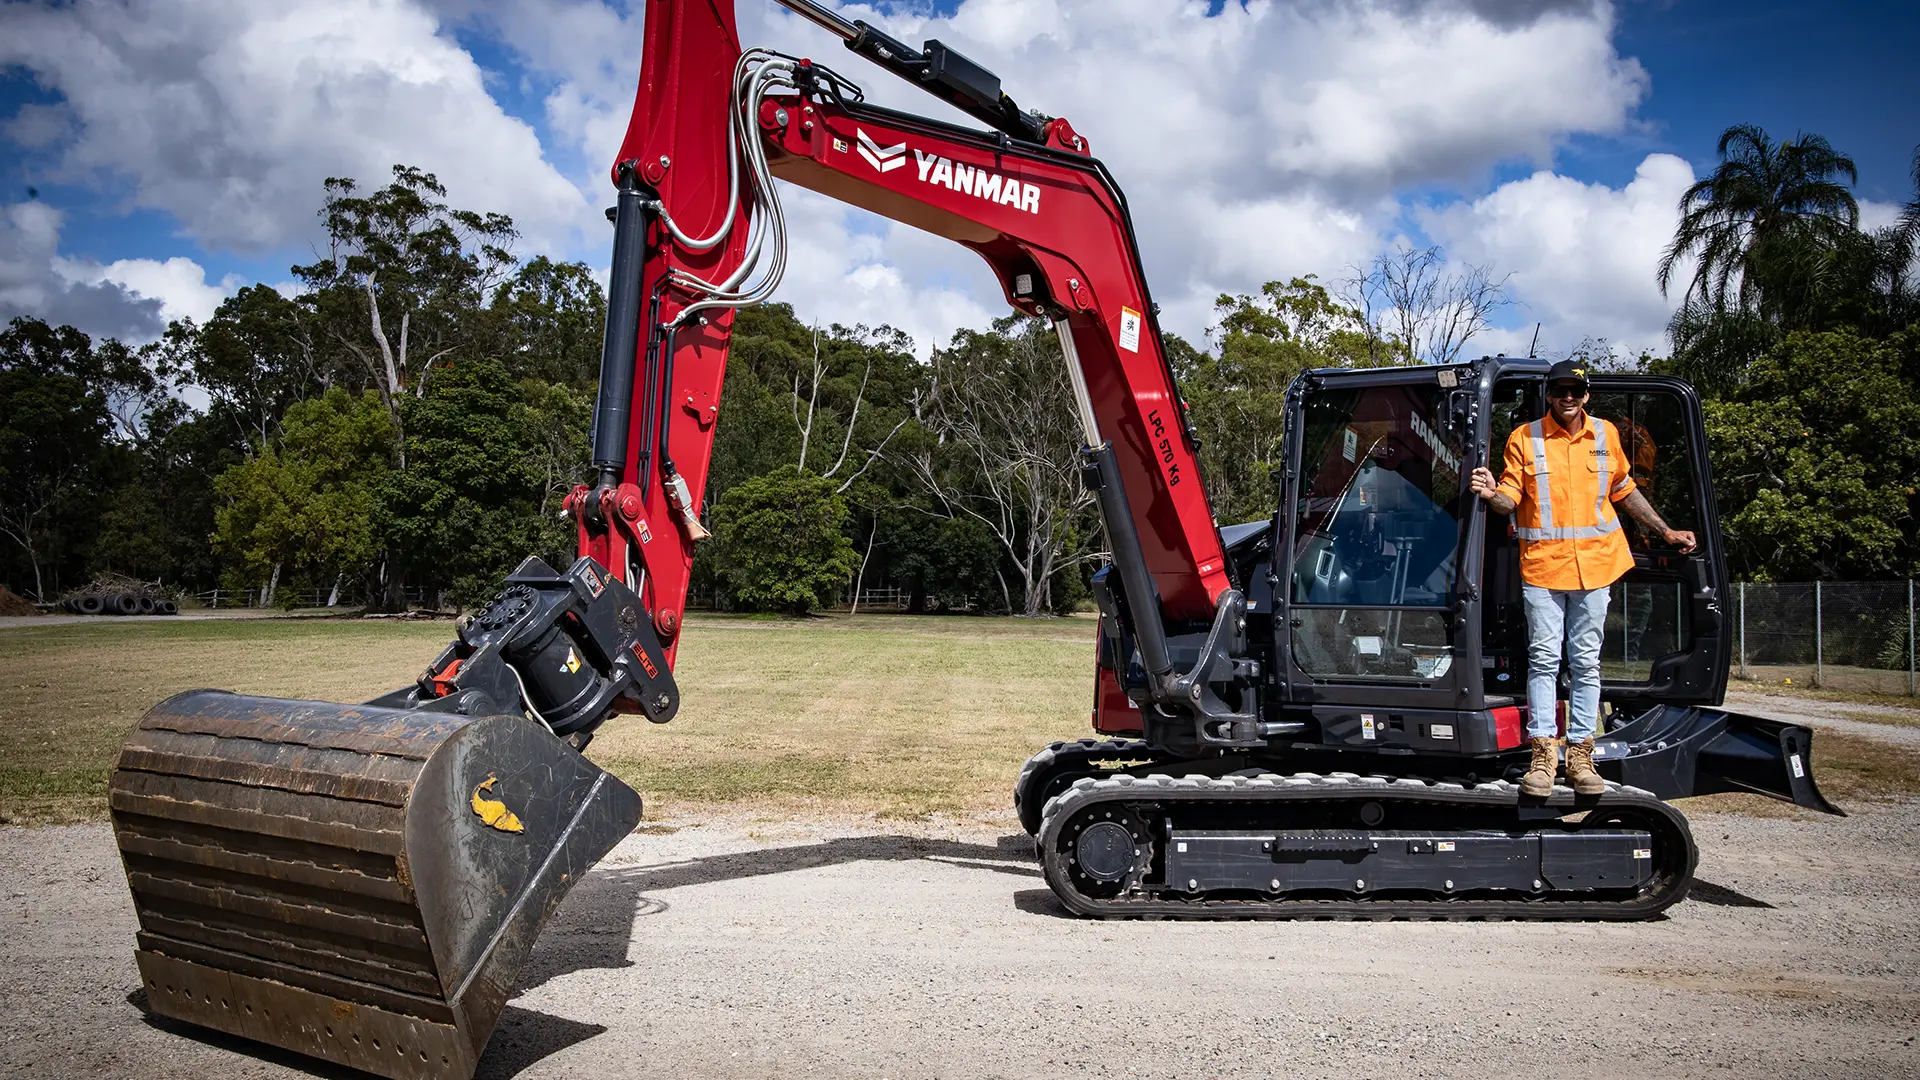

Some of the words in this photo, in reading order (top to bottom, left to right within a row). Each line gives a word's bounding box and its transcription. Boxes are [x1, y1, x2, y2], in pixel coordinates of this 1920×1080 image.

[914, 148, 1041, 215] YANMAR
[1148, 409, 1165, 438] LPC
[1159, 438, 1174, 464] 570
[1168, 466, 1180, 487] Kg
[633, 643, 657, 677] ELITE
